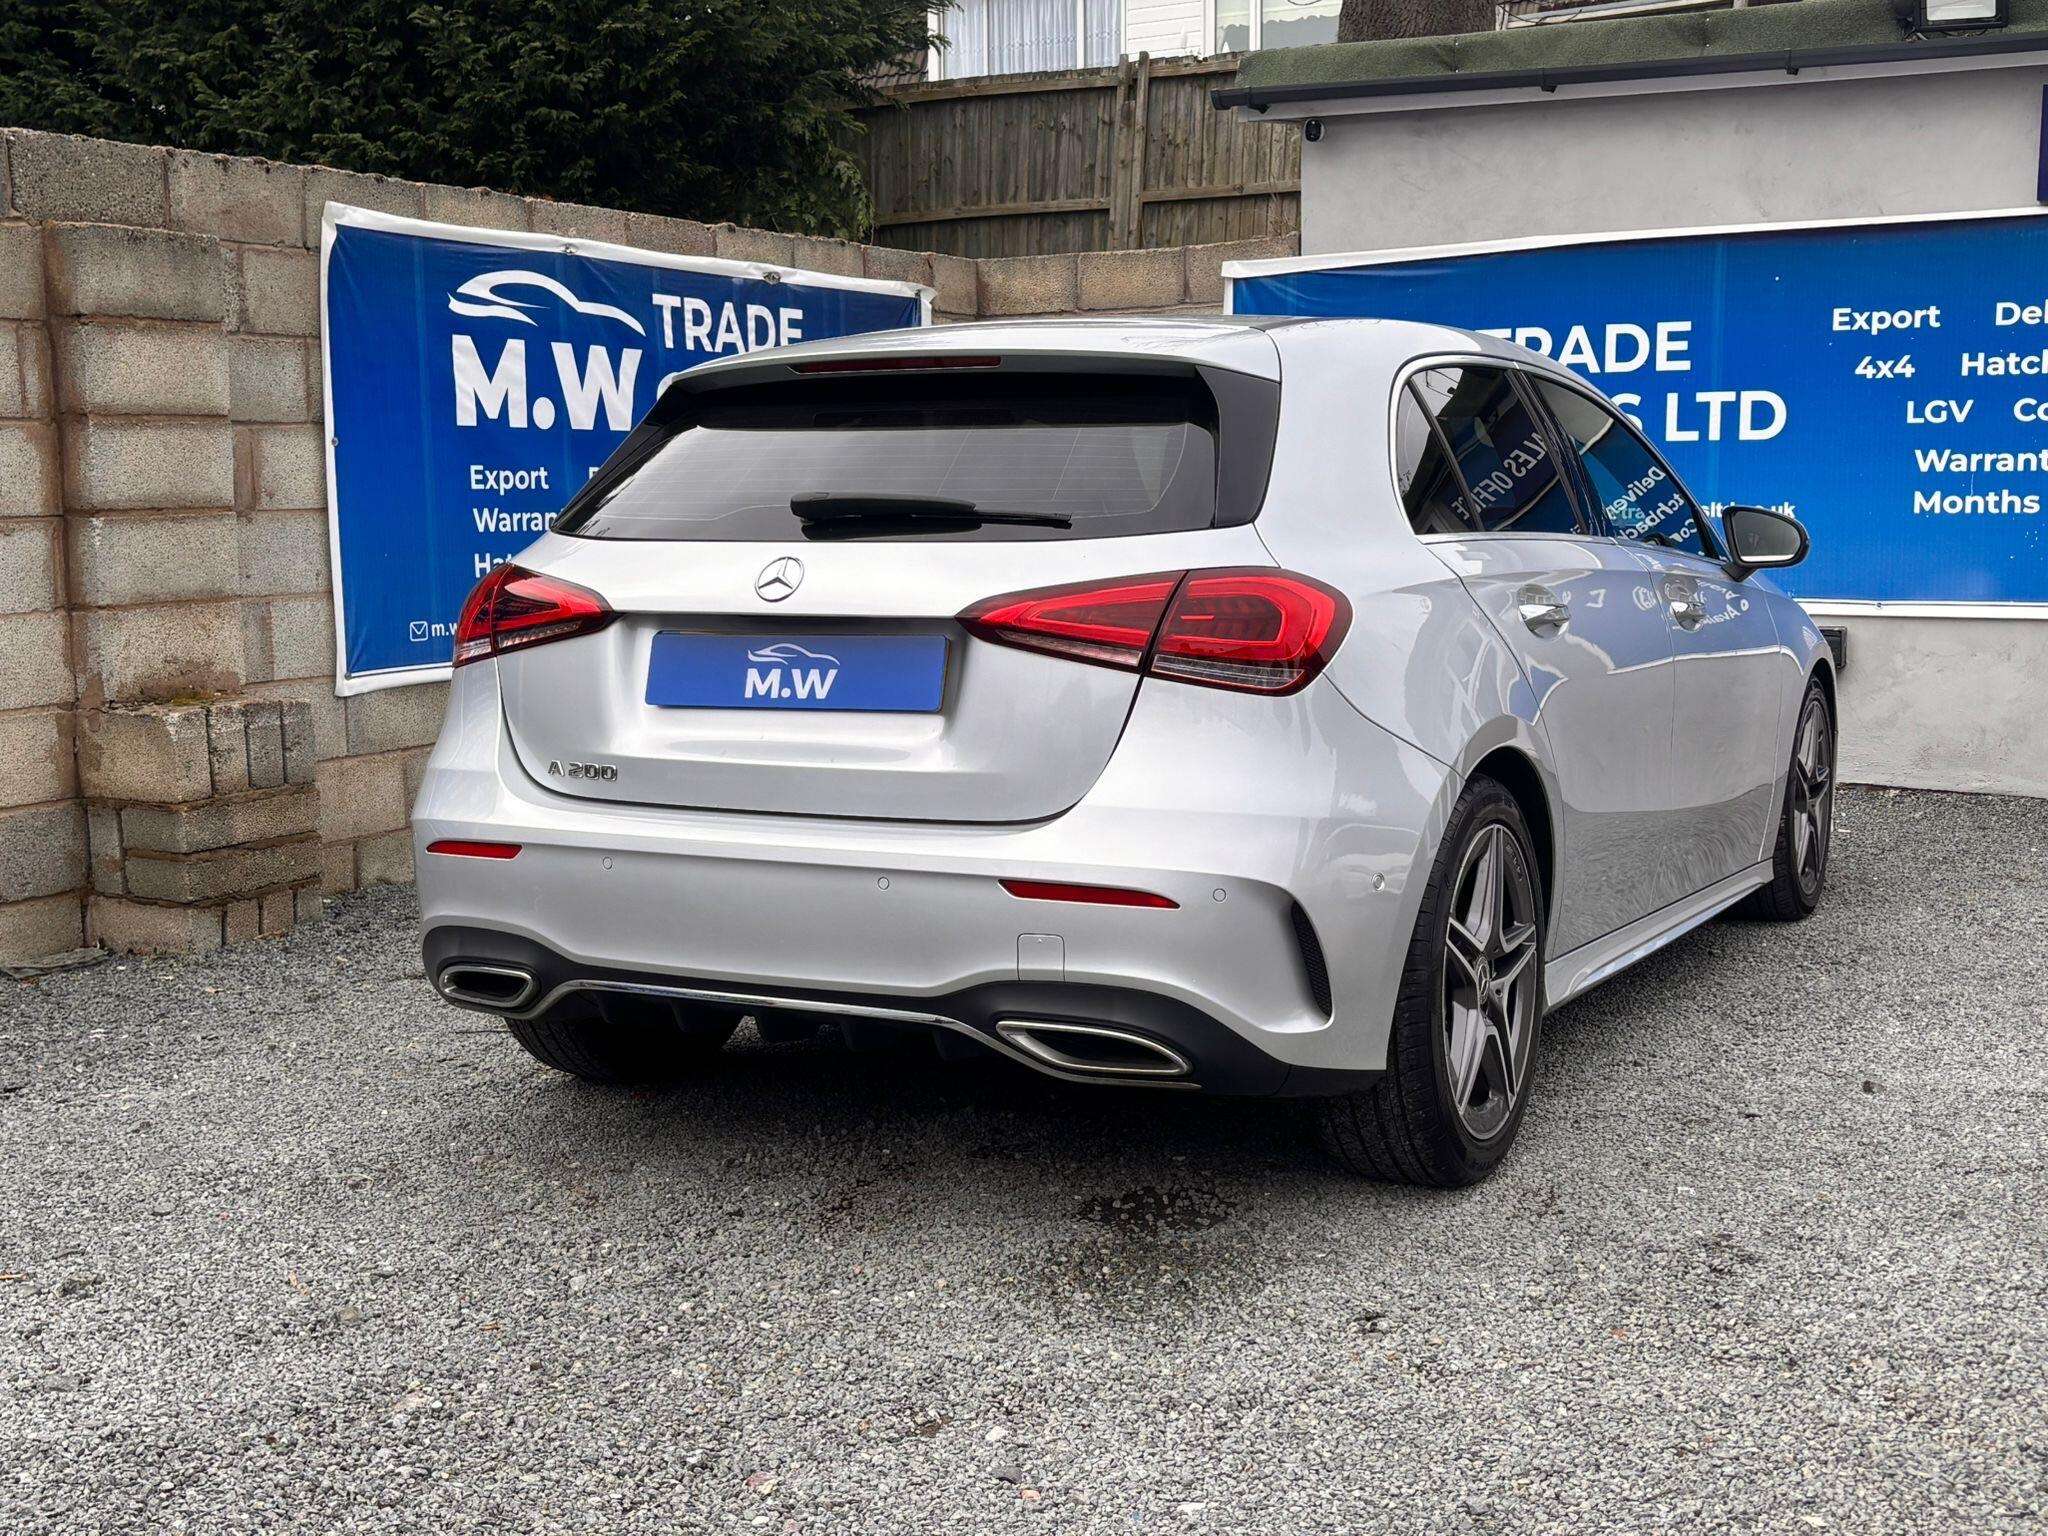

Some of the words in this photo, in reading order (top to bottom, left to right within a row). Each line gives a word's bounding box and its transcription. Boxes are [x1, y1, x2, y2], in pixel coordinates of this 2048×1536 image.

[652, 293, 803, 354] TRADE
[1832, 306, 1941, 335] Export
[1855, 355, 1916, 379] 4x4
[452, 335, 643, 431] M.W
[1665, 390, 1787, 442] LTD
[1906, 399, 1974, 424] LGV
[470, 465, 549, 495] Export
[1913, 489, 2041, 514] Months
[472, 507, 563, 533] Warran
[744, 668, 839, 700] M.W
[548, 759, 565, 777] A
[568, 761, 618, 781] 200
